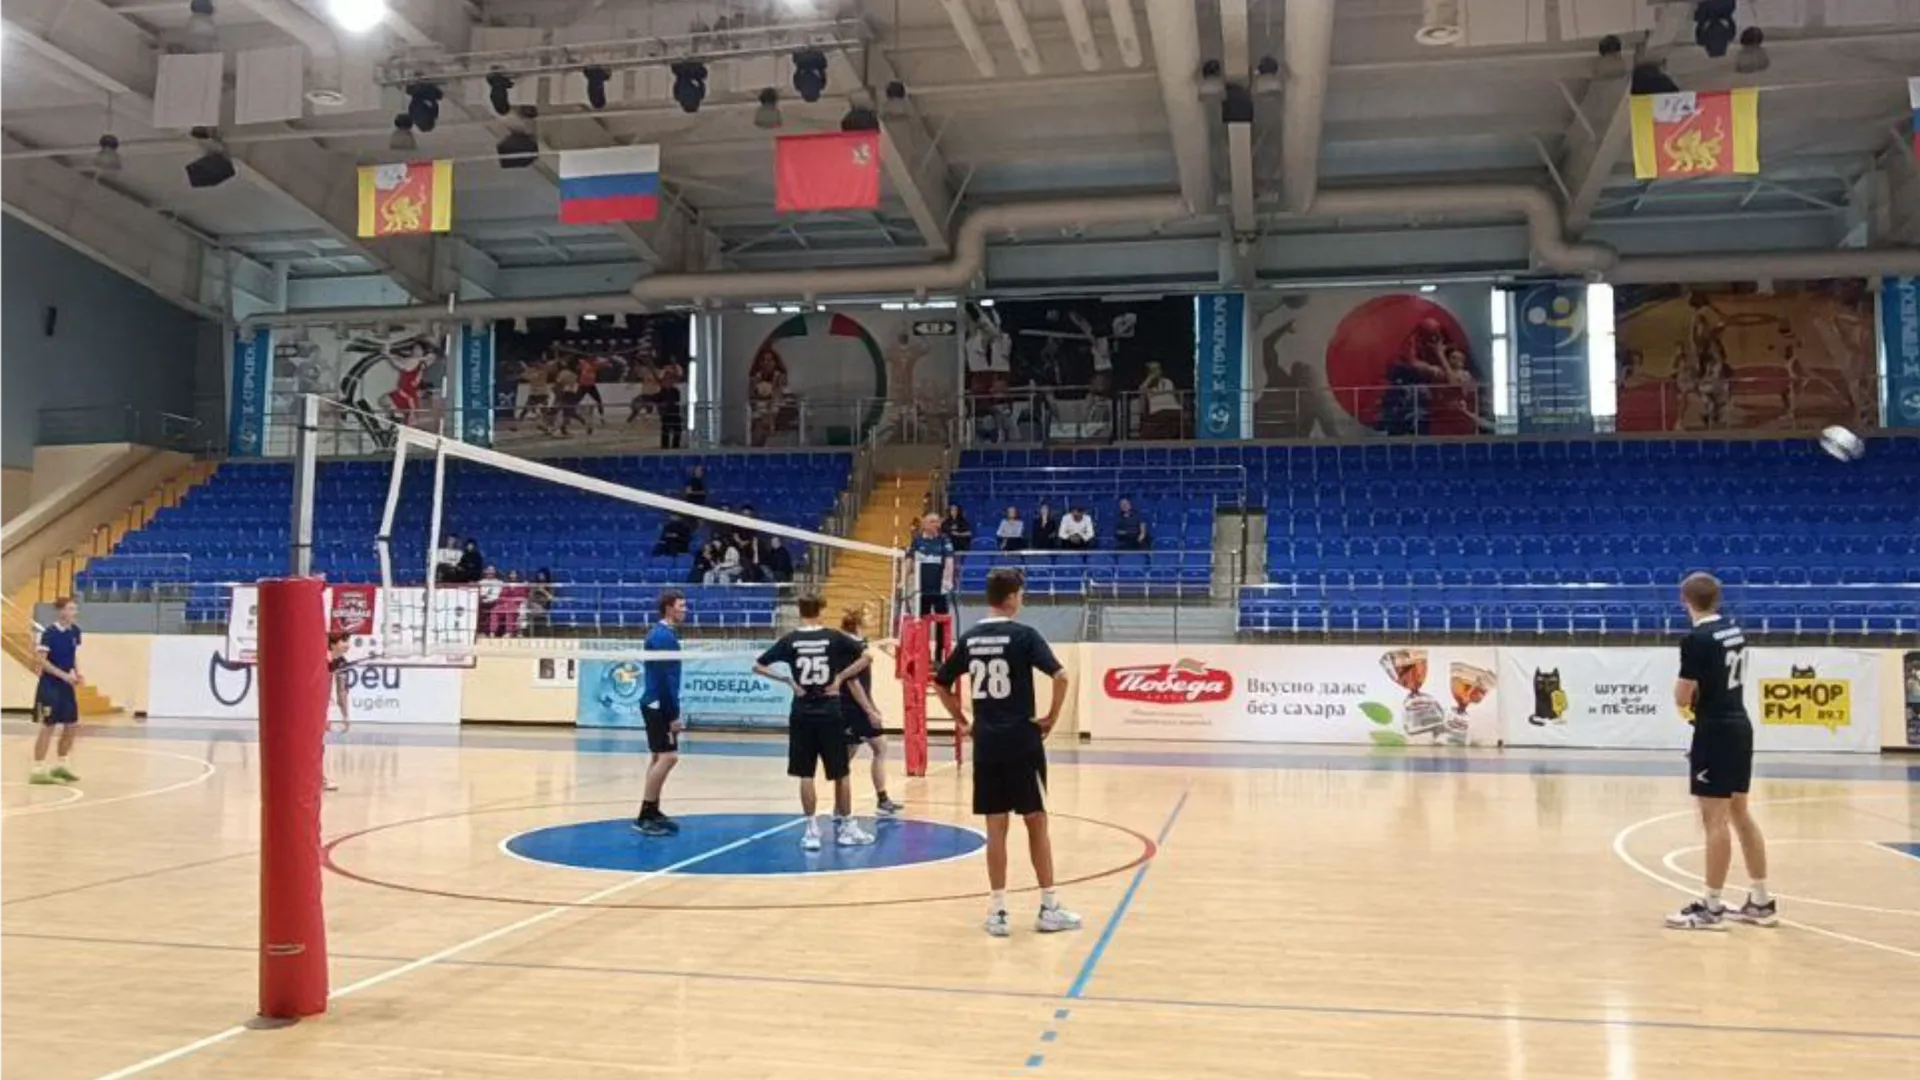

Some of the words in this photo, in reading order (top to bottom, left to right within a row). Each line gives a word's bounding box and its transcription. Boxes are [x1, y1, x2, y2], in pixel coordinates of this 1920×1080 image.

[796, 656, 830, 685] 25
[969, 658, 1011, 699] 28
[684, 678, 770, 693] «ПОБЕДА»
[1114, 664, 1225, 701] Победа
[1247, 678, 1314, 695] Вкусно
[1320, 682, 1367, 695] даже
[1594, 684, 1649, 695] ШУТКИ
[1763, 683, 1844, 707] ЮМОР
[1247, 700, 1278, 714] без
[1283, 703, 1347, 719] сахара
[1763, 703, 1802, 719] FM
